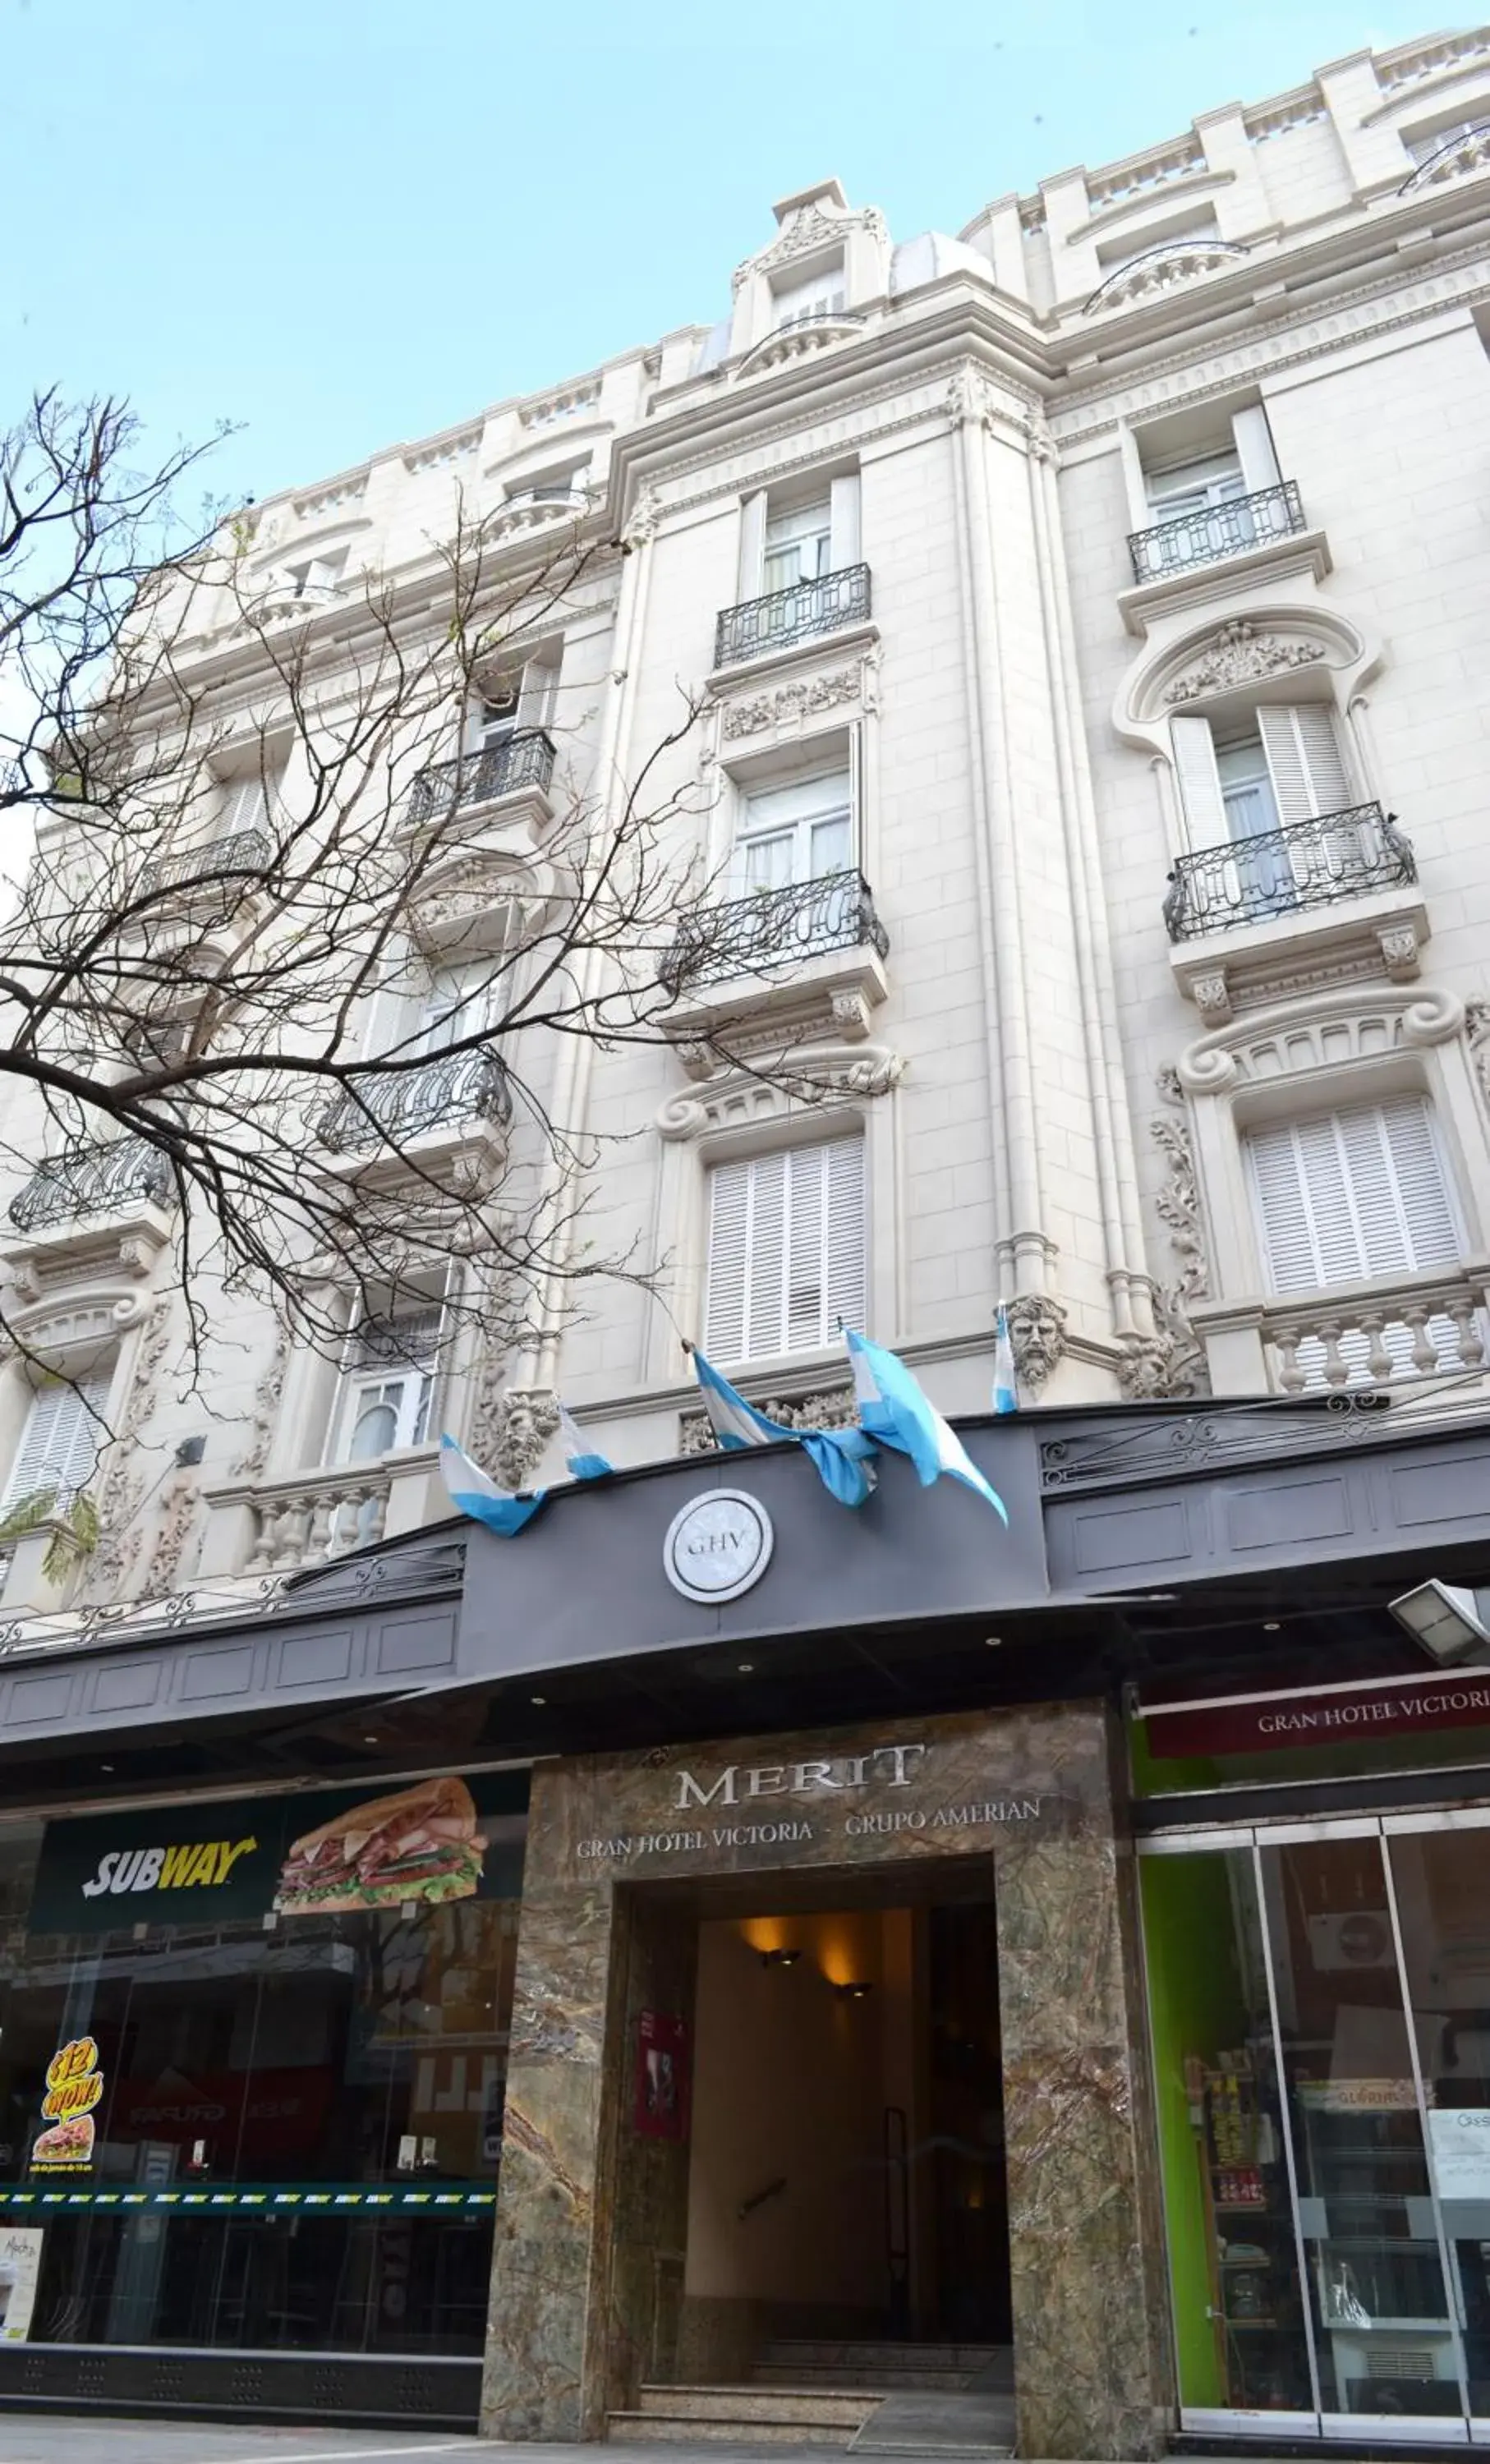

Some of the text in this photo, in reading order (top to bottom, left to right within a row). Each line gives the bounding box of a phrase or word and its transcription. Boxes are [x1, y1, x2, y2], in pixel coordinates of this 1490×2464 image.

[688, 1531, 746, 1555] GHV
[1258, 1689, 1490, 1732] GRAN HOTEL VICTORI
[674, 1744, 925, 1809] MERIT
[577, 1838, 632, 1859] GRAN
[638, 1831, 708, 1853] HOTEL
[713, 1821, 813, 1848] VICTORIA
[845, 1811, 927, 1836] GRUPO
[933, 1799, 1041, 1827] AMERIAN
[82, 1836, 257, 1899] SUBWAY
